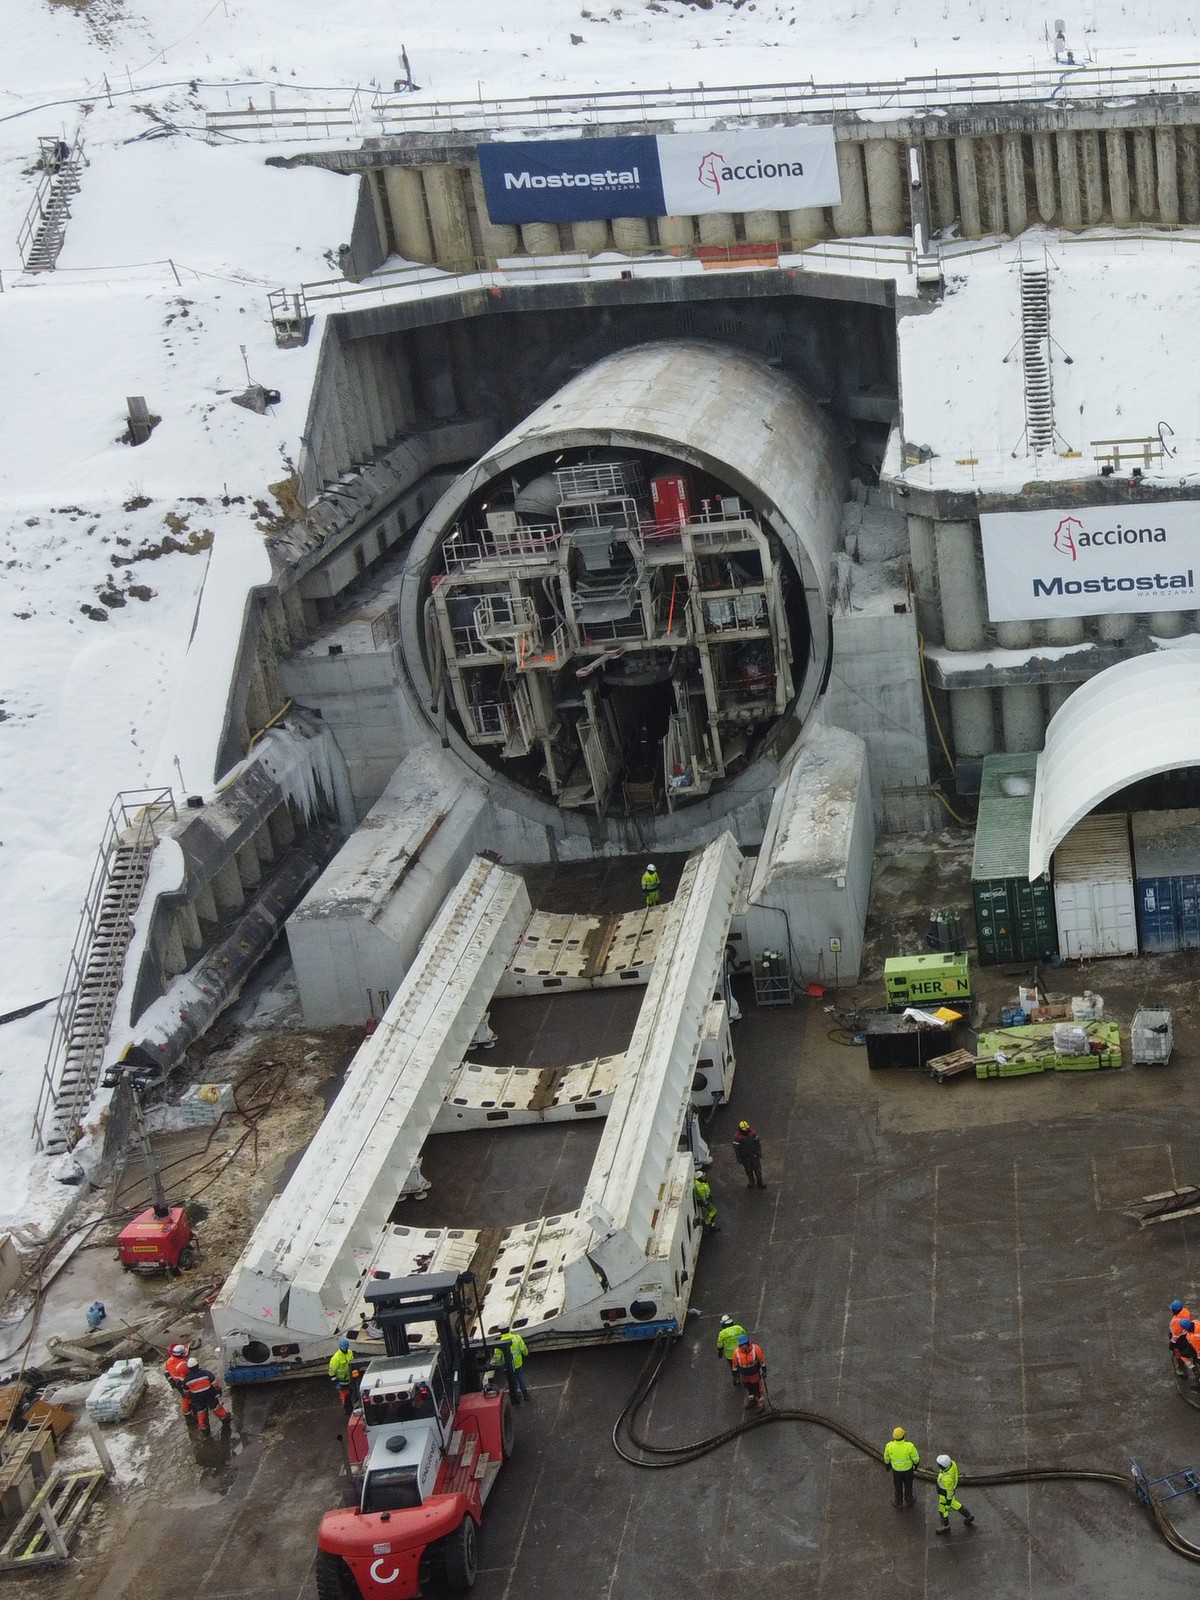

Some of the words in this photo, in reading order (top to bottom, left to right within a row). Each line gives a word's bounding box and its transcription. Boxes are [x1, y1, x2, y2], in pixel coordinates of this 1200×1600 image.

[504, 167, 640, 190] Mostostal
[721, 159, 804, 181] acciona
[592, 184, 641, 192] WARSZAWA
[1078, 524, 1167, 547] acciona
[1033, 569, 1194, 597] Mostostal
[1137, 589, 1195, 597] WARSZAWA
